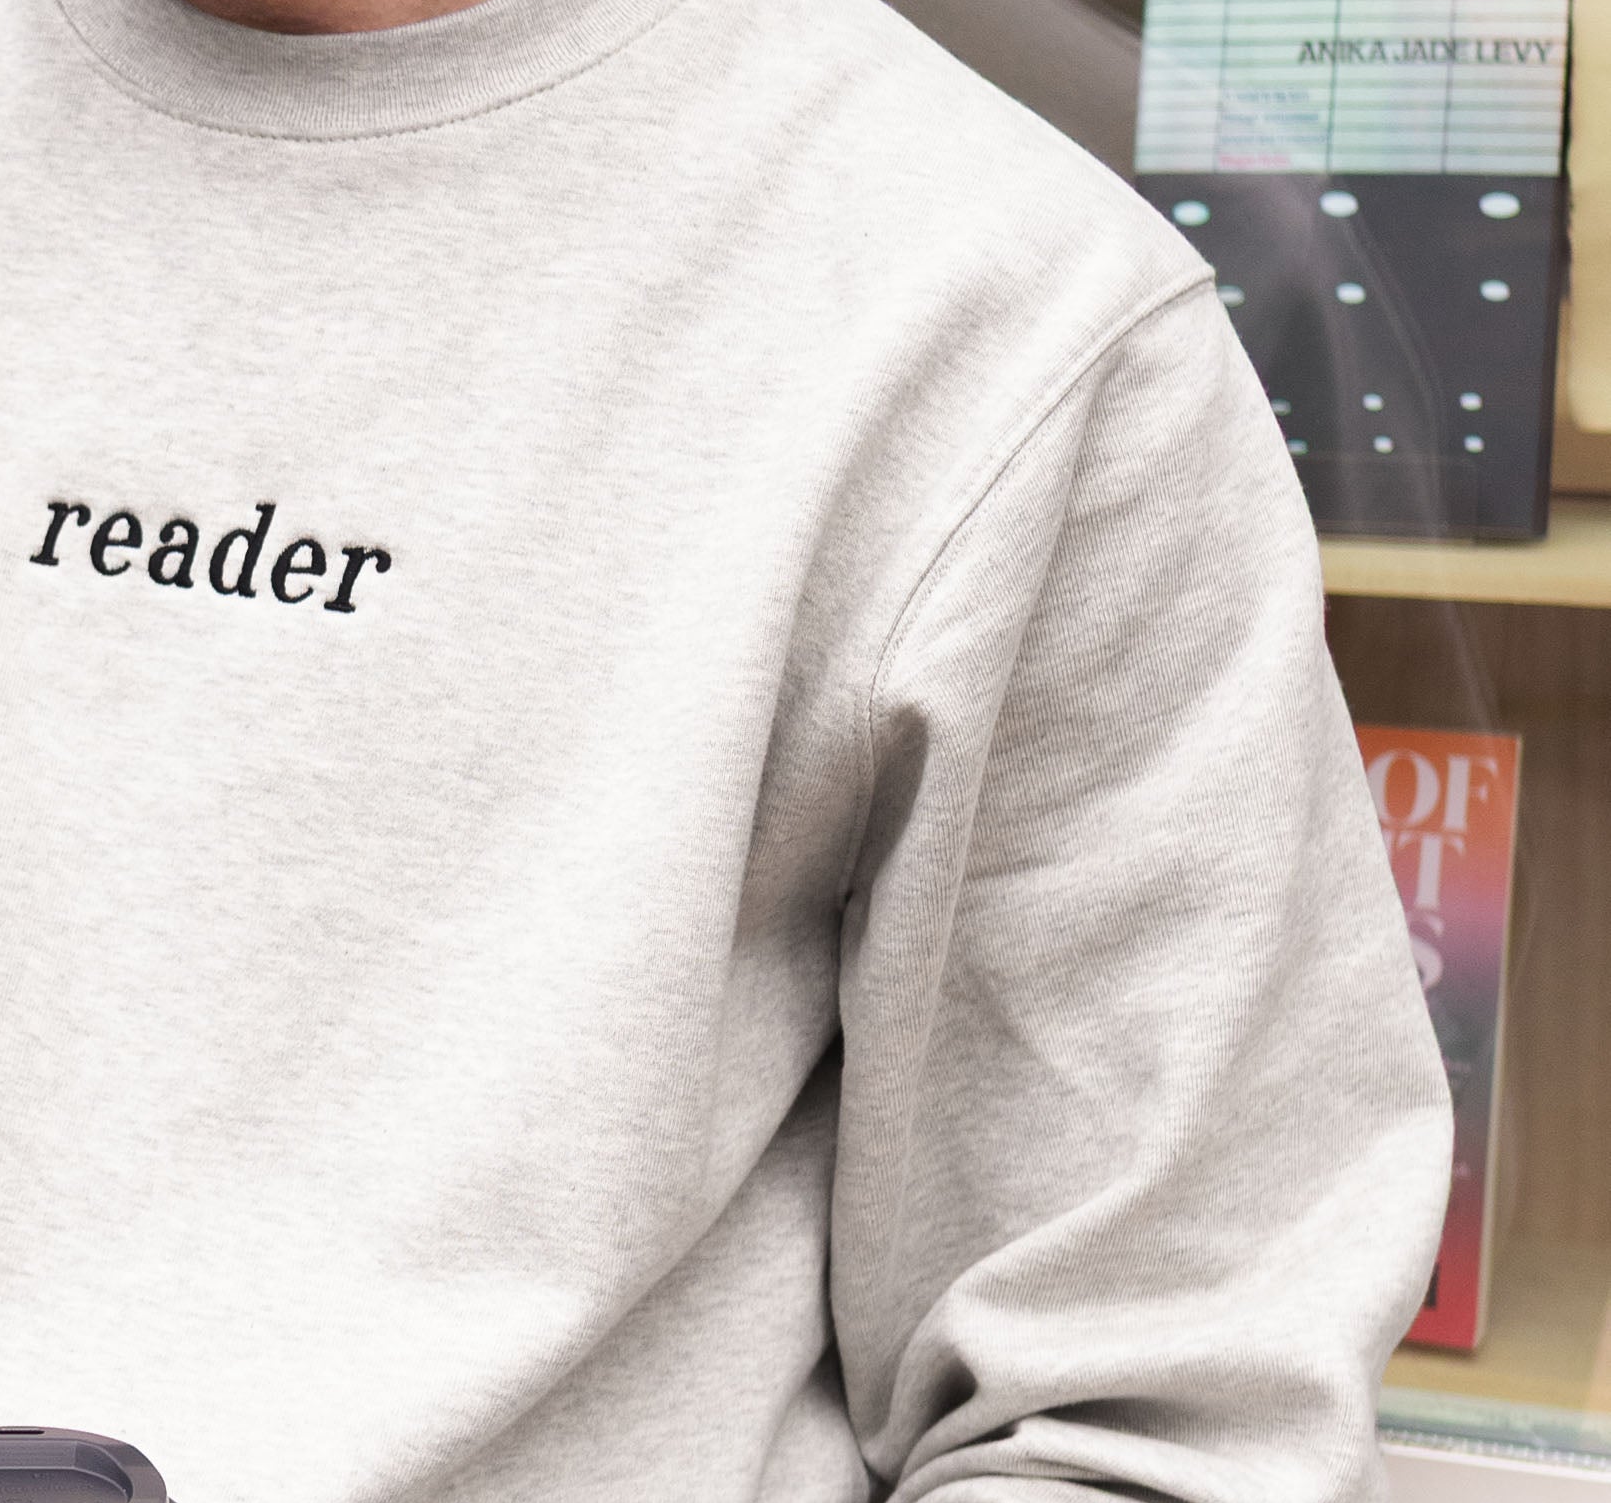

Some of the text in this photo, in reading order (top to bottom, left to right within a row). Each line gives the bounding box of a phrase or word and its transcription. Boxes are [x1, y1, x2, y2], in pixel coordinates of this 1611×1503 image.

[1297, 37, 1555, 65] ANIKA JADE LEVY
[30, 502, 391, 612] reader
[1362, 747, 1498, 832] OF
